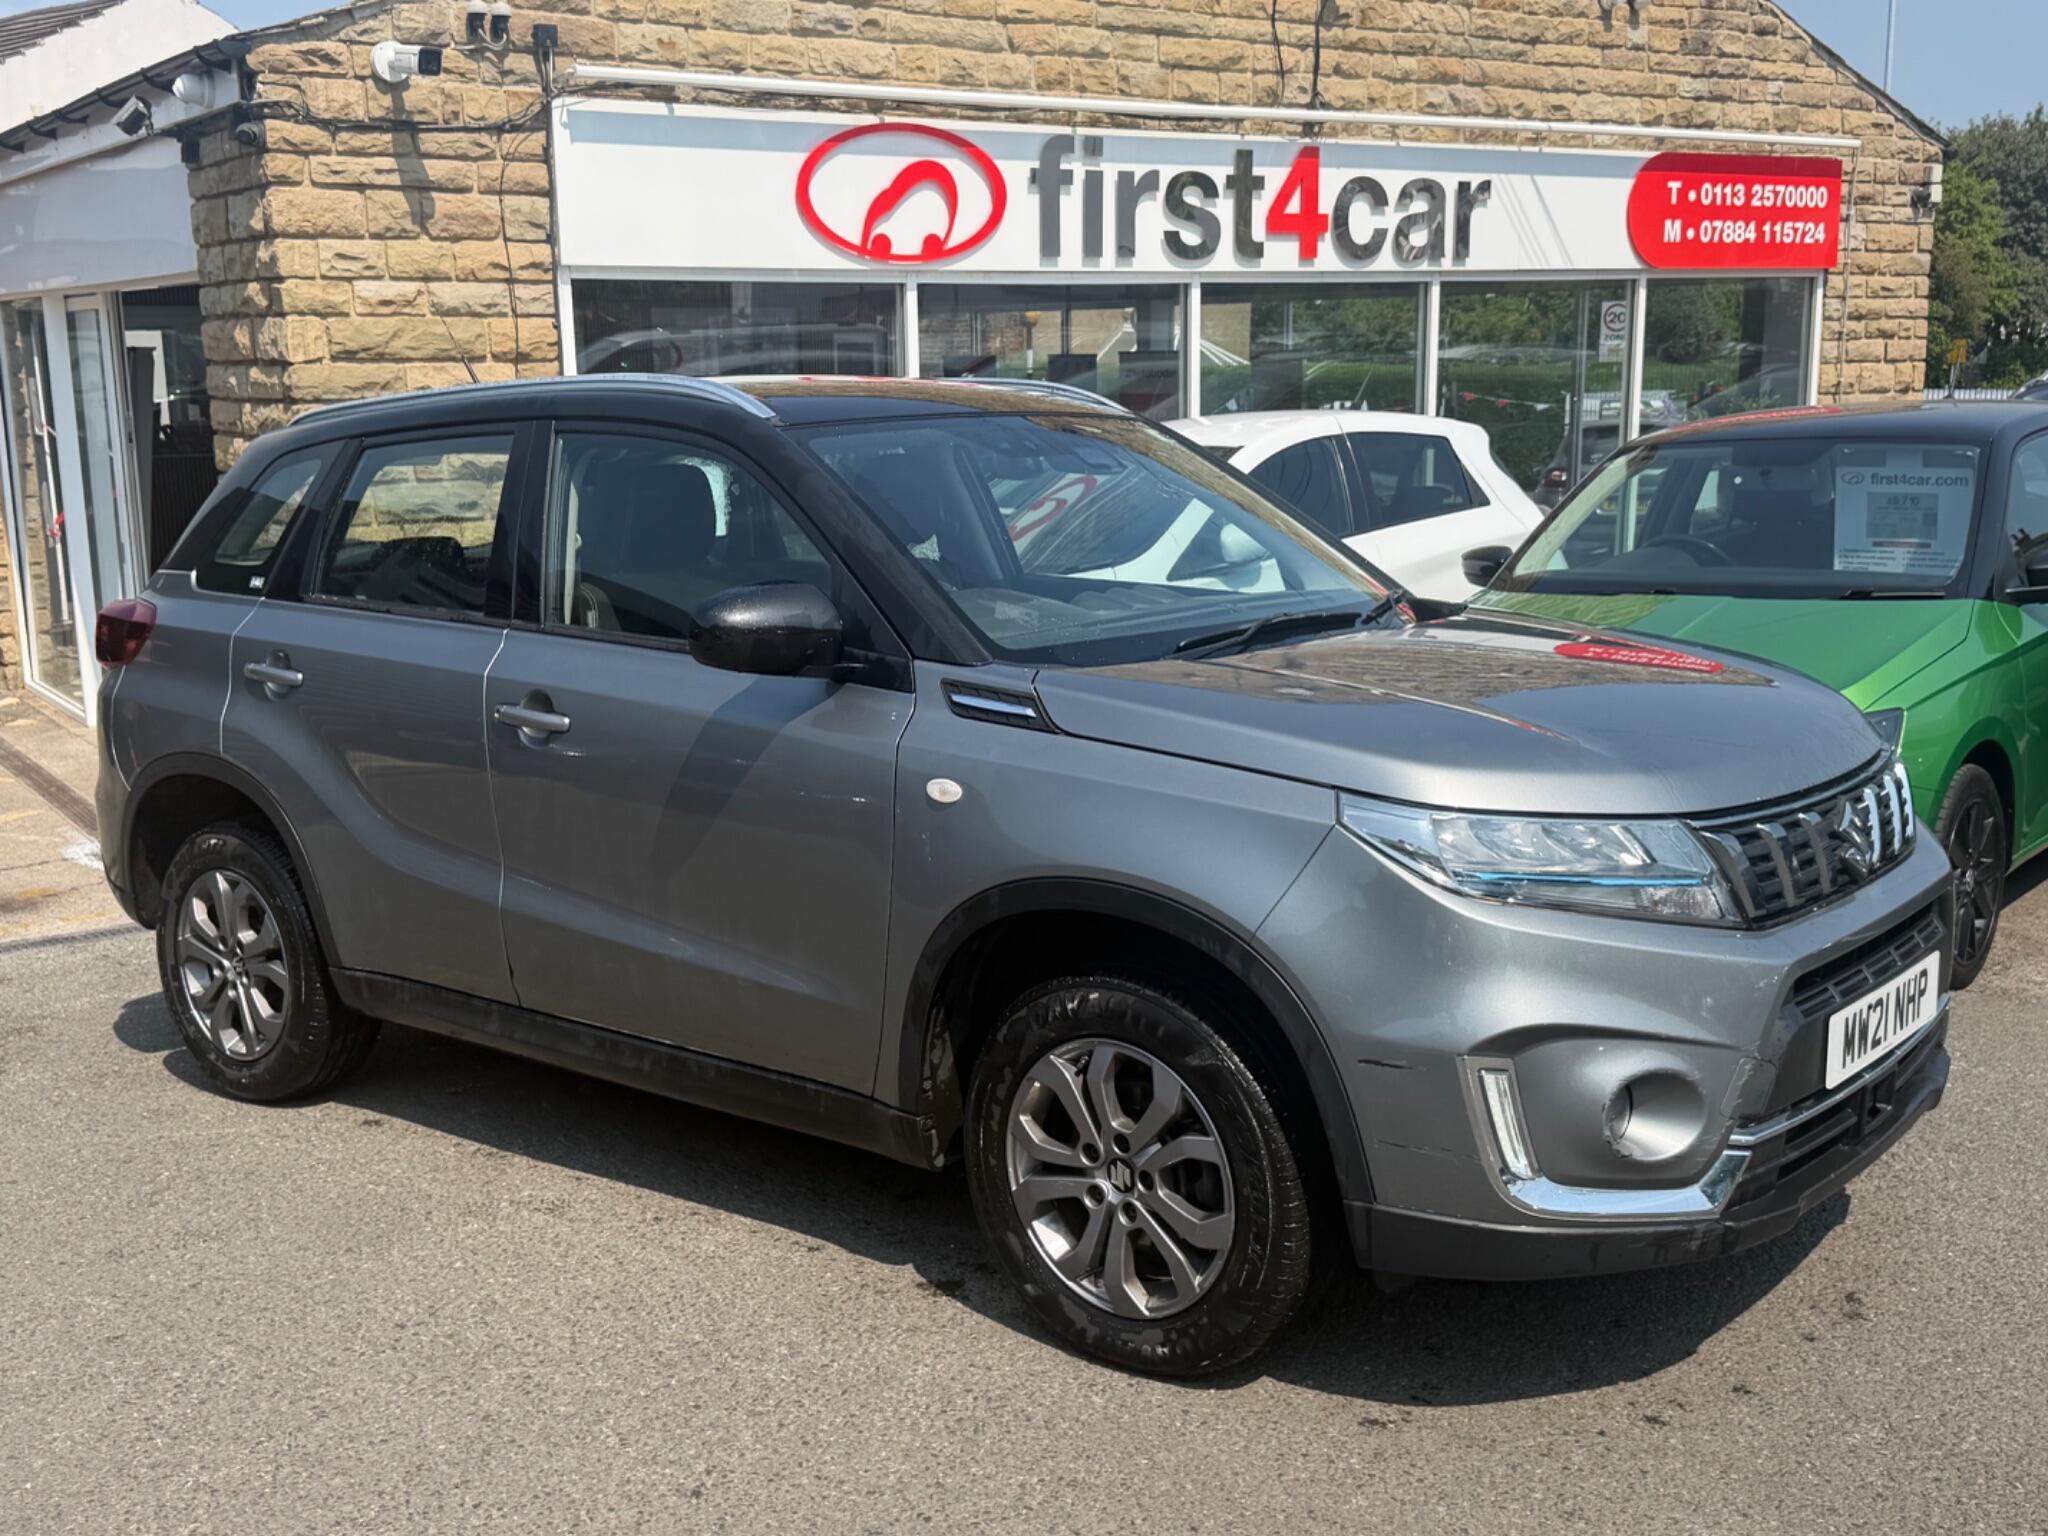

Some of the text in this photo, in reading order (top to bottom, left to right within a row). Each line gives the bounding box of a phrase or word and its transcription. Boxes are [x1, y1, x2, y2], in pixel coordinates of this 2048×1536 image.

[1030, 135, 1491, 261] first4car
[1667, 181, 1828, 209] T 0113 2570000
[1663, 219, 1826, 245] M 07884 115724
[1608, 311, 1626, 324] 20
[1870, 472, 1969, 488] first4car.com
[1842, 967, 1928, 1069] MW21 NHP
